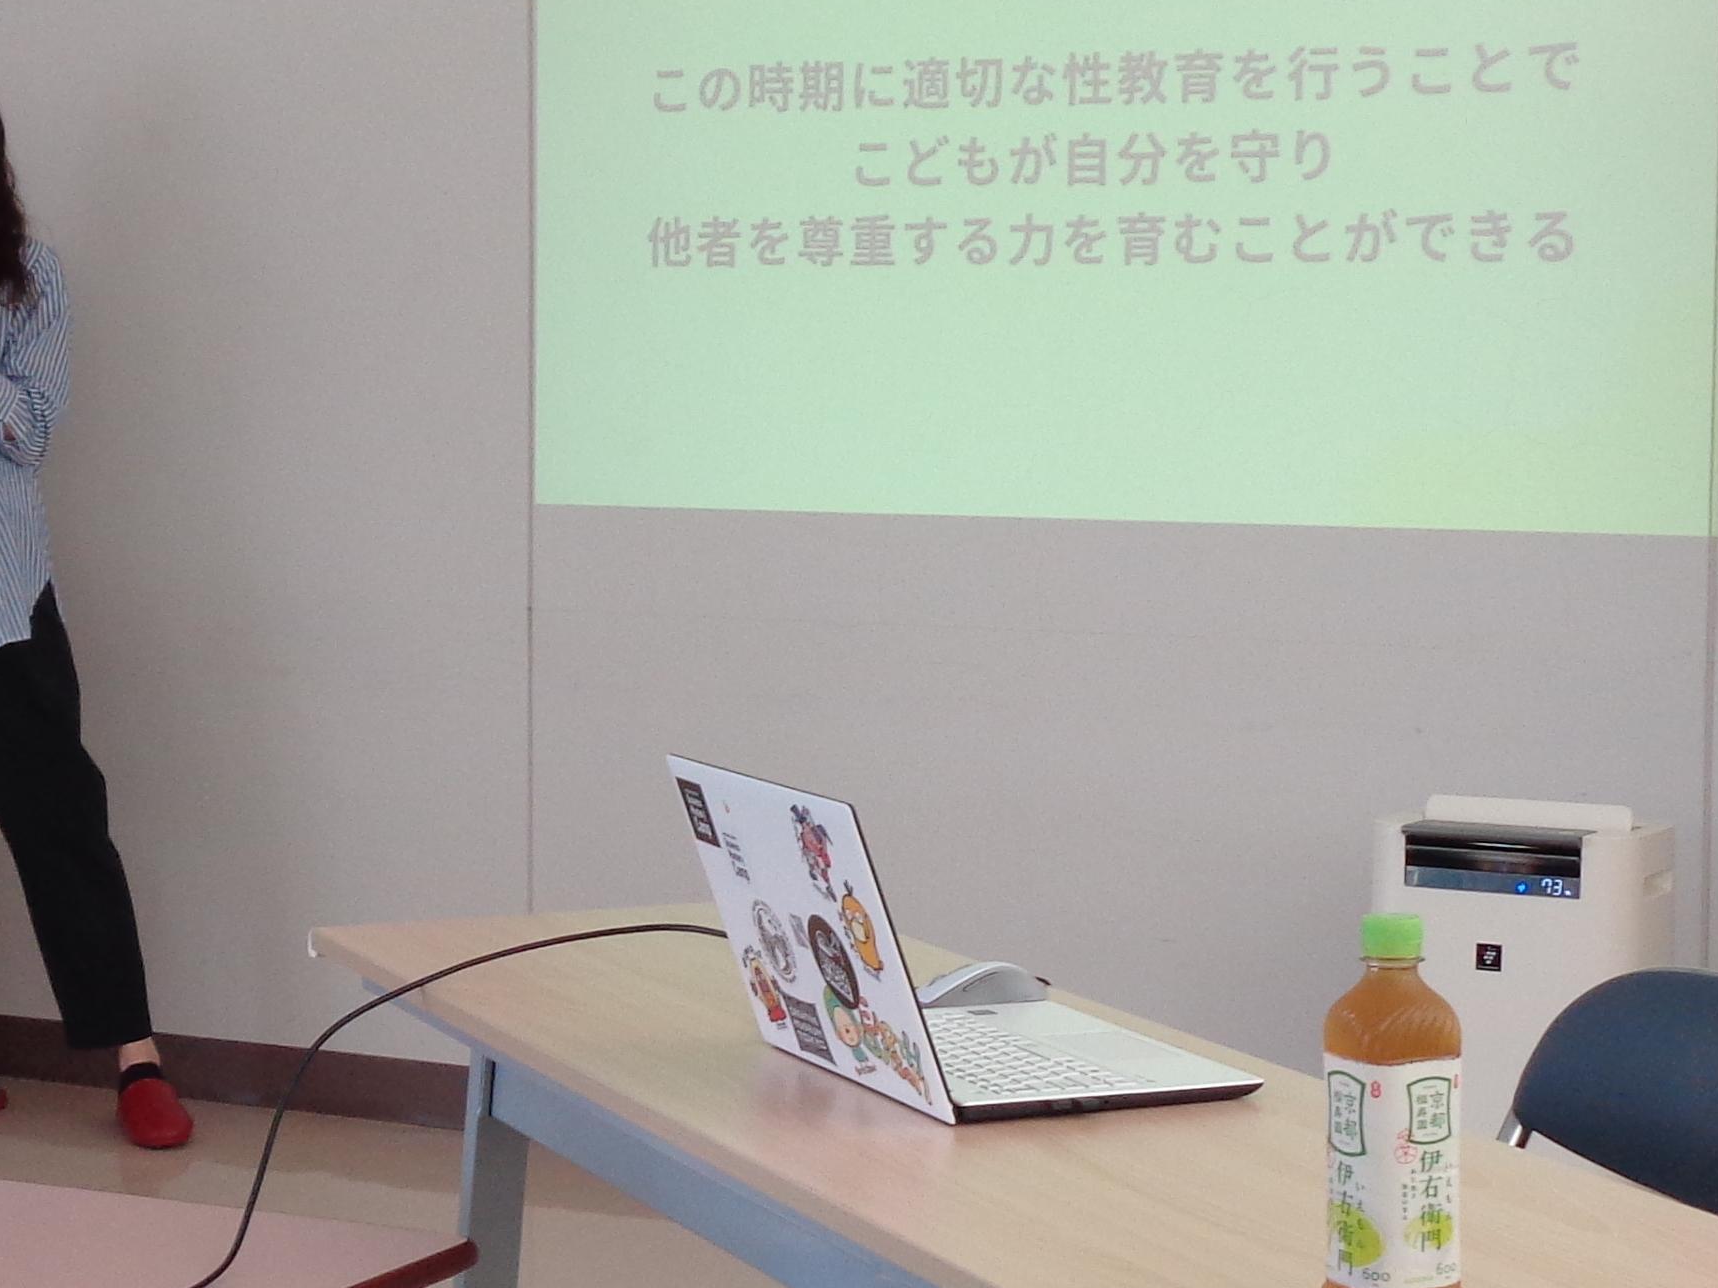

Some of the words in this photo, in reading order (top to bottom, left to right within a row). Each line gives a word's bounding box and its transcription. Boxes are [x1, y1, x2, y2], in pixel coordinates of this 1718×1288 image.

[652, 40, 1581, 114] この時期に適切な性教育を行うことで
[853, 128, 1333, 189] こどもが自分を守り
[647, 206, 1577, 270] 他者を尊重する力を育むことができる
[1541, 878, 1563, 896] 73
[1419, 1150, 1443, 1253] 伊右衛門
